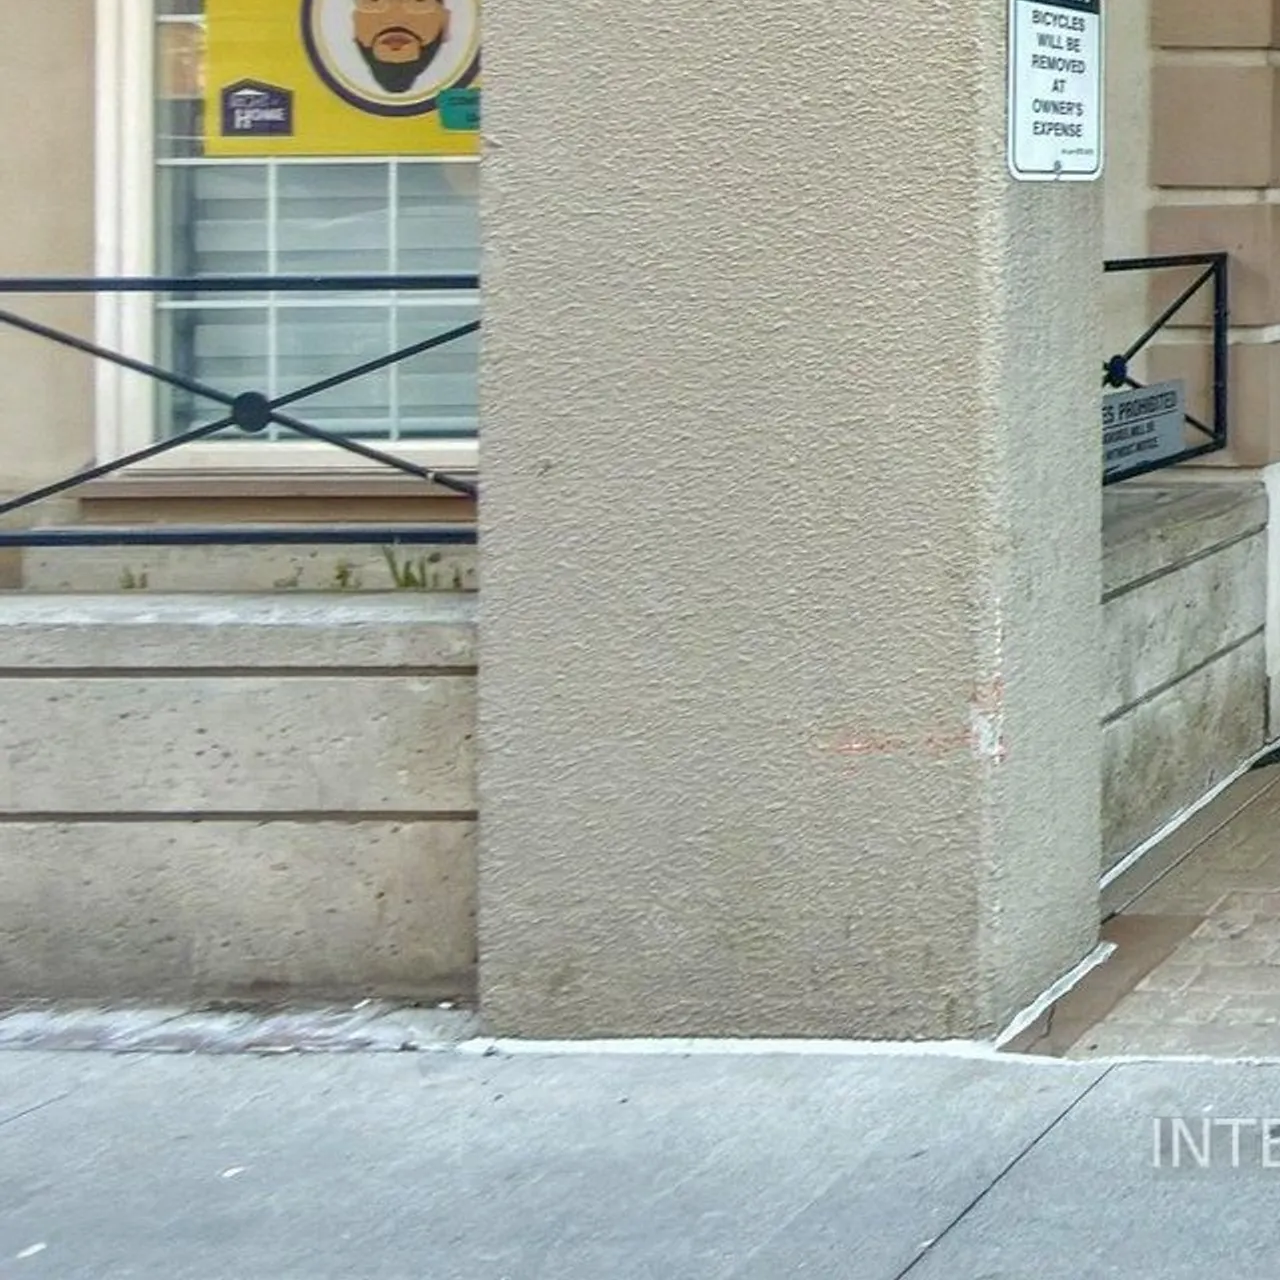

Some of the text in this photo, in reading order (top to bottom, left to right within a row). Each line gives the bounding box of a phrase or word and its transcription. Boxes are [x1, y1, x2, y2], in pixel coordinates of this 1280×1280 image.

[1031, 9, 1085, 33] BICYCLES
[1036, 32, 1081, 54] WILL BE
[1031, 53, 1085, 74] REMOVED
[1051, 79, 1066, 93] AT
[1032, 98, 1084, 117] OWNER'S
[1032, 121, 1083, 138] EXPENSE
[1118, 390, 1176, 422] PROHIBITED
